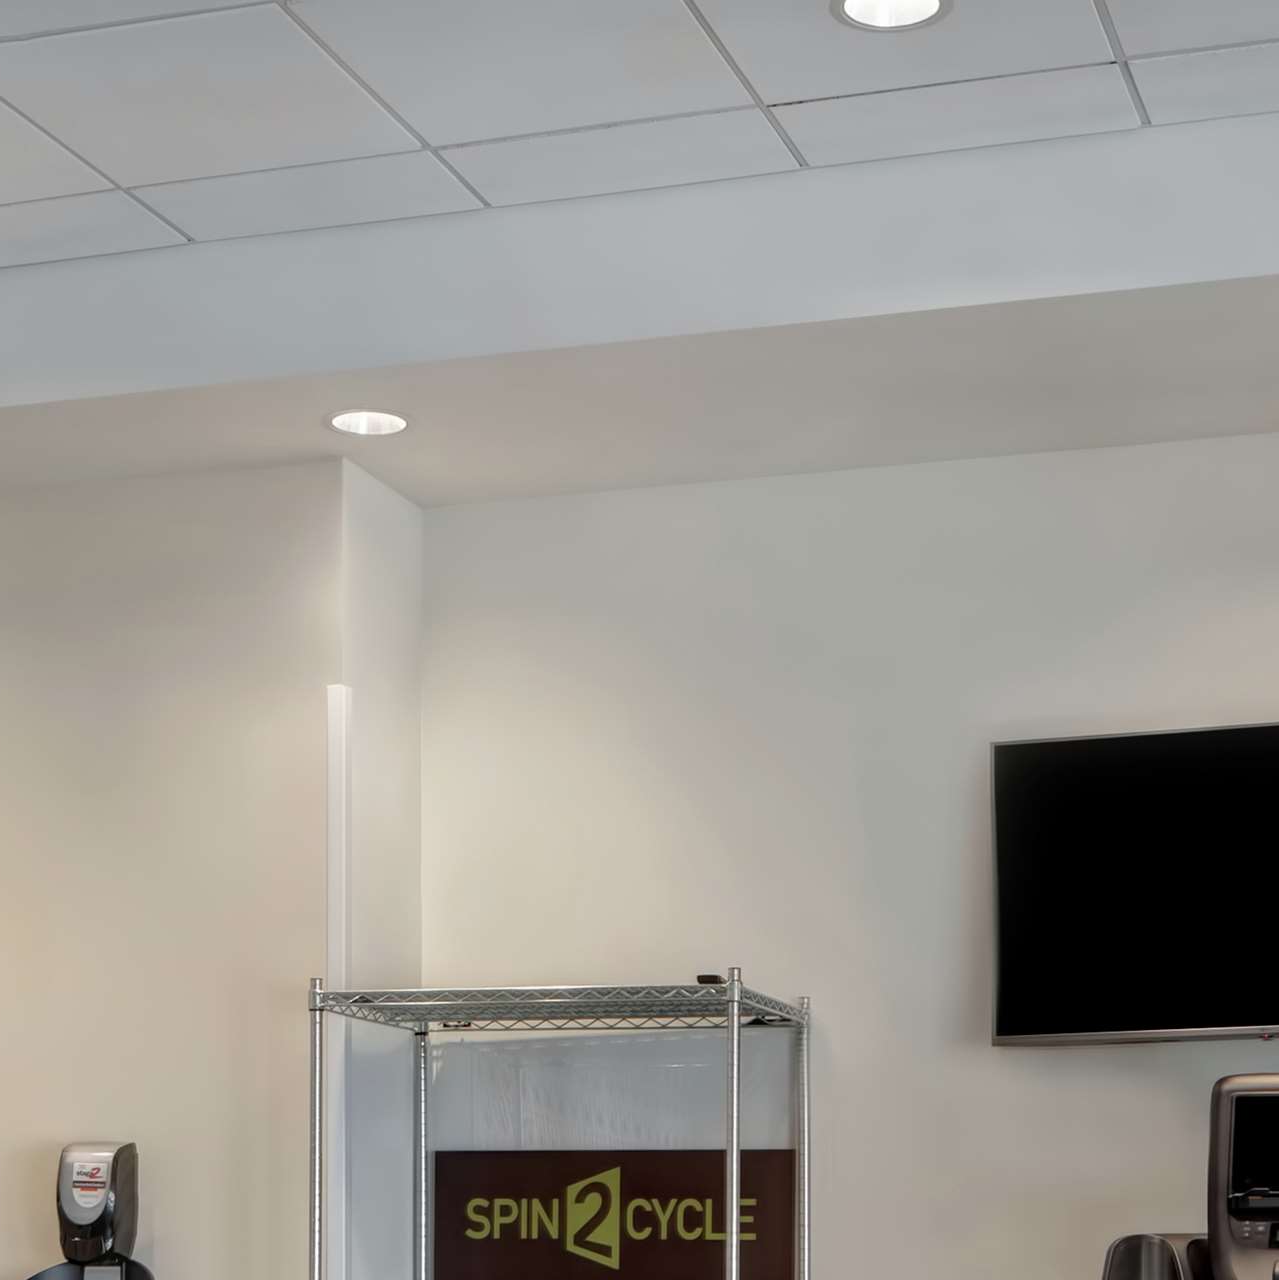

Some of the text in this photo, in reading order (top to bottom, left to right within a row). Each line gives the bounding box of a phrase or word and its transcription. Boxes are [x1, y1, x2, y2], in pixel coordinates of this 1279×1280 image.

[464, 1181, 758, 1259] SPIN 2 CYCLE
